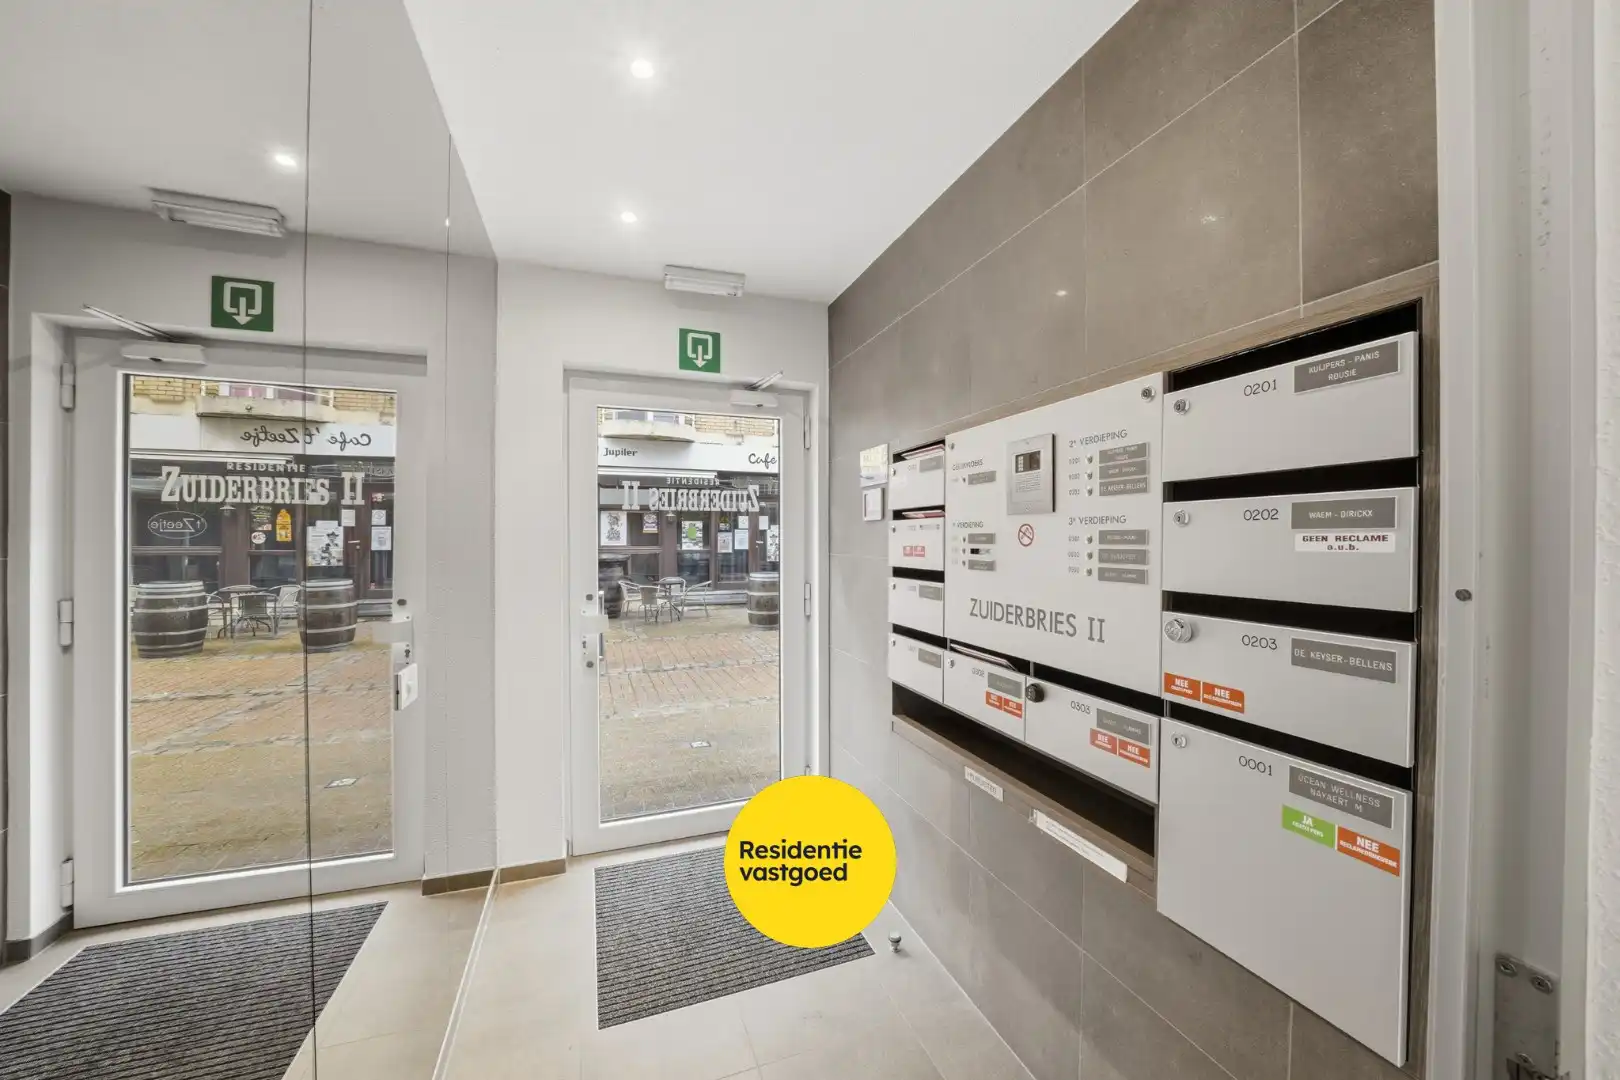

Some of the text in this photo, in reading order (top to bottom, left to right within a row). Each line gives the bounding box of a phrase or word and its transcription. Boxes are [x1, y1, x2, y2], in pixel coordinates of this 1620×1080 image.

[1308, 359, 1346, 374] KUIJPERS
[1354, 350, 1380, 363] PANIS
[1327, 368, 1357, 381] ROUSIE
[1243, 379, 1277, 396] 0201
[1079, 429, 1128, 446] VERDIEPING
[603, 447, 638, 457] Jupiler
[227, 462, 306, 473] RESIDENTIE
[160, 465, 366, 506] ZUIDERBRIES II
[1079, 514, 1127, 525] VERDIEPING
[1243, 508, 1279, 521] 0202
[1308, 511, 1332, 519] WAEM
[1340, 509, 1373, 519] DIRICKX
[1302, 534, 1389, 543] GEEN RECLAME
[969, 597, 1106, 643] ZUIDERBRIES II
[1241, 634, 1278, 650] 0203
[1294, 648, 1393, 672] DE KEYSER-BELLENS
[1174, 678, 1189, 689] NEE
[1214, 687, 1231, 699] NEE
[1070, 700, 1092, 715] 0303
[1238, 755, 1273, 777] 0001
[1298, 773, 1381, 808] OCEAN WELLNESS
[1302, 815, 1314, 828] JA
[1356, 836, 1380, 854] NEE
